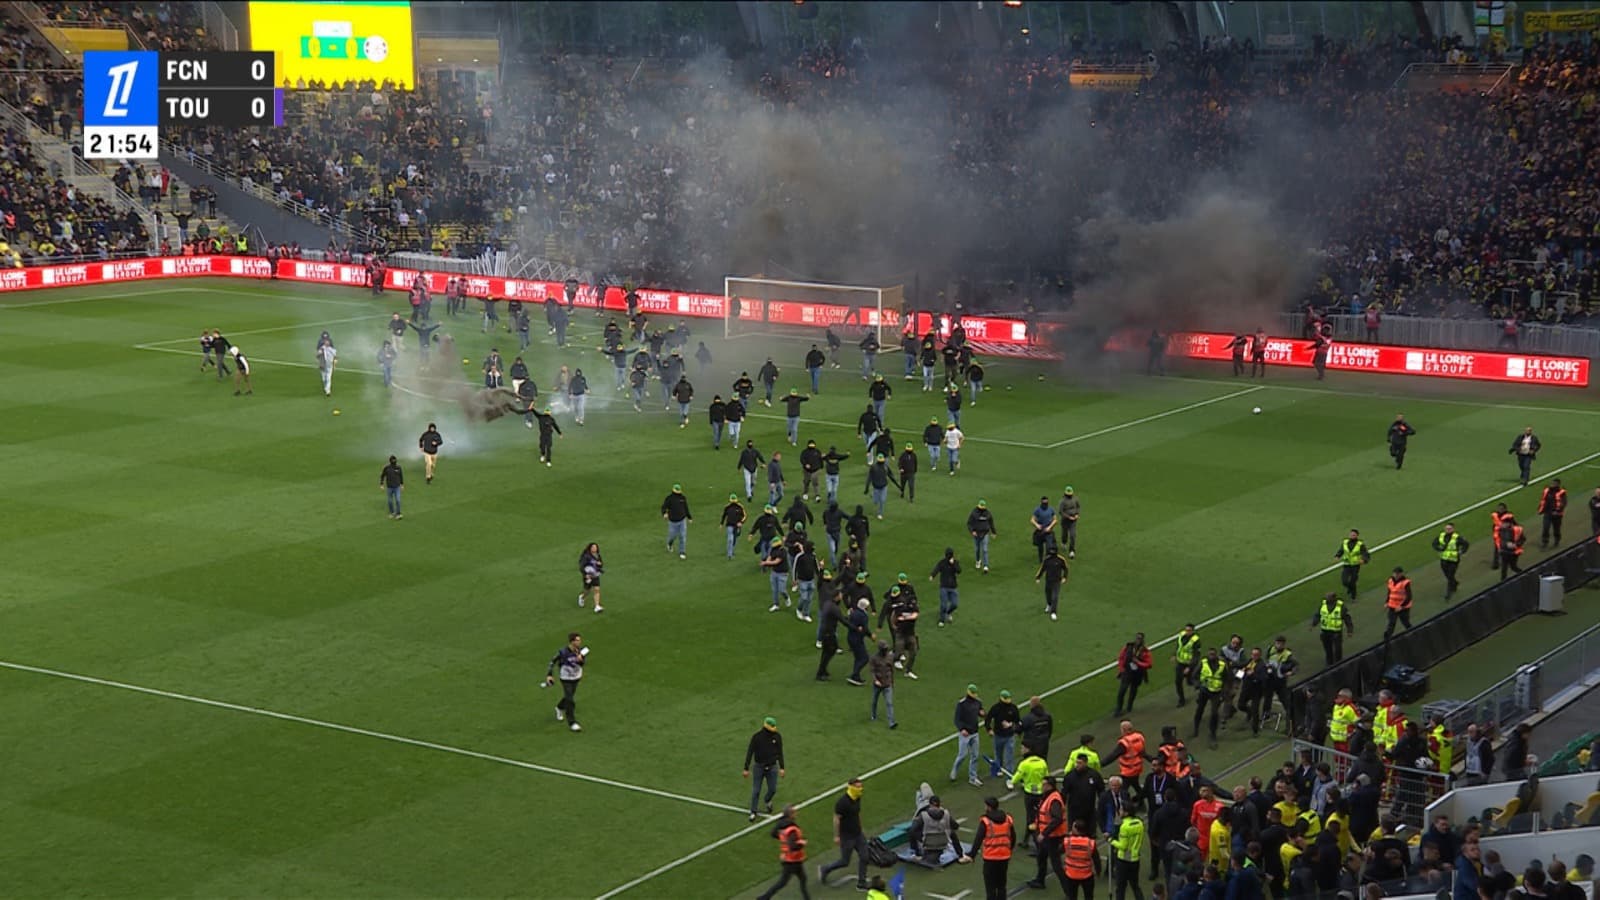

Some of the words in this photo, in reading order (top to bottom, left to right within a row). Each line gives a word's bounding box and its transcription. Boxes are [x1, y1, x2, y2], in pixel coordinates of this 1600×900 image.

[176, 258, 186, 266] LE
[1334, 347, 1345, 356] LE
[1347, 348, 1380, 358] LOREC
[1334, 357, 1379, 368] GROUPE
[1425, 353, 1437, 364] LE
[1440, 354, 1475, 366] LOREC
[1425, 364, 1474, 375] GROUPE
[1528, 359, 1540, 369] LE
[1543, 360, 1580, 372] LOREC
[1527, 370, 1578, 382] GROUPE
